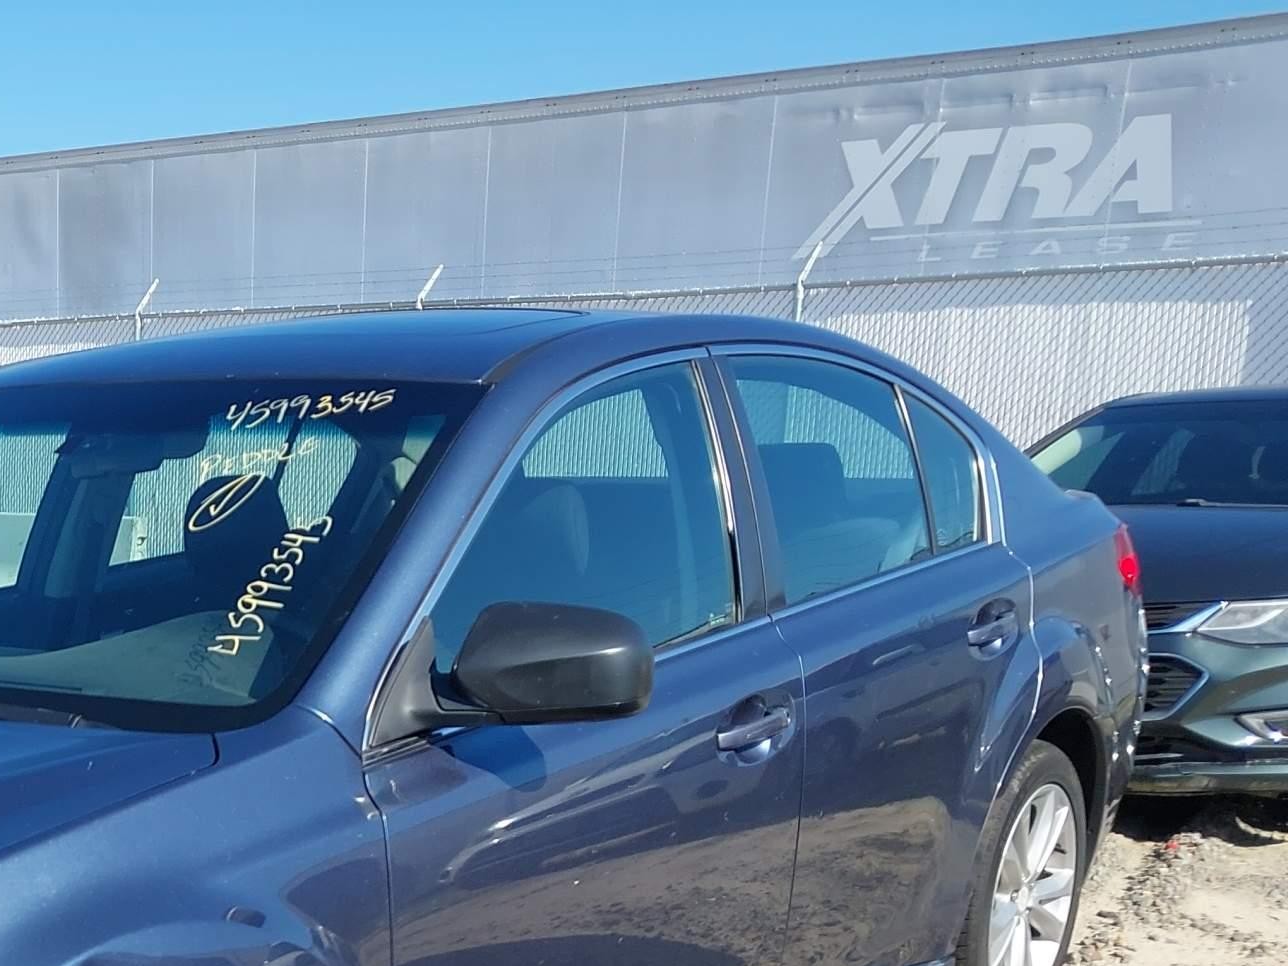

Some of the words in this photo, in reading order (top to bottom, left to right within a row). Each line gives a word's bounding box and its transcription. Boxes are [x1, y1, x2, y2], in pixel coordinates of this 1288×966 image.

[792, 113, 1173, 260] XTRA
[916, 232, 1199, 263] LEASE
[226, 388, 397, 430] 45993545
[207, 515, 333, 656] 45993545
